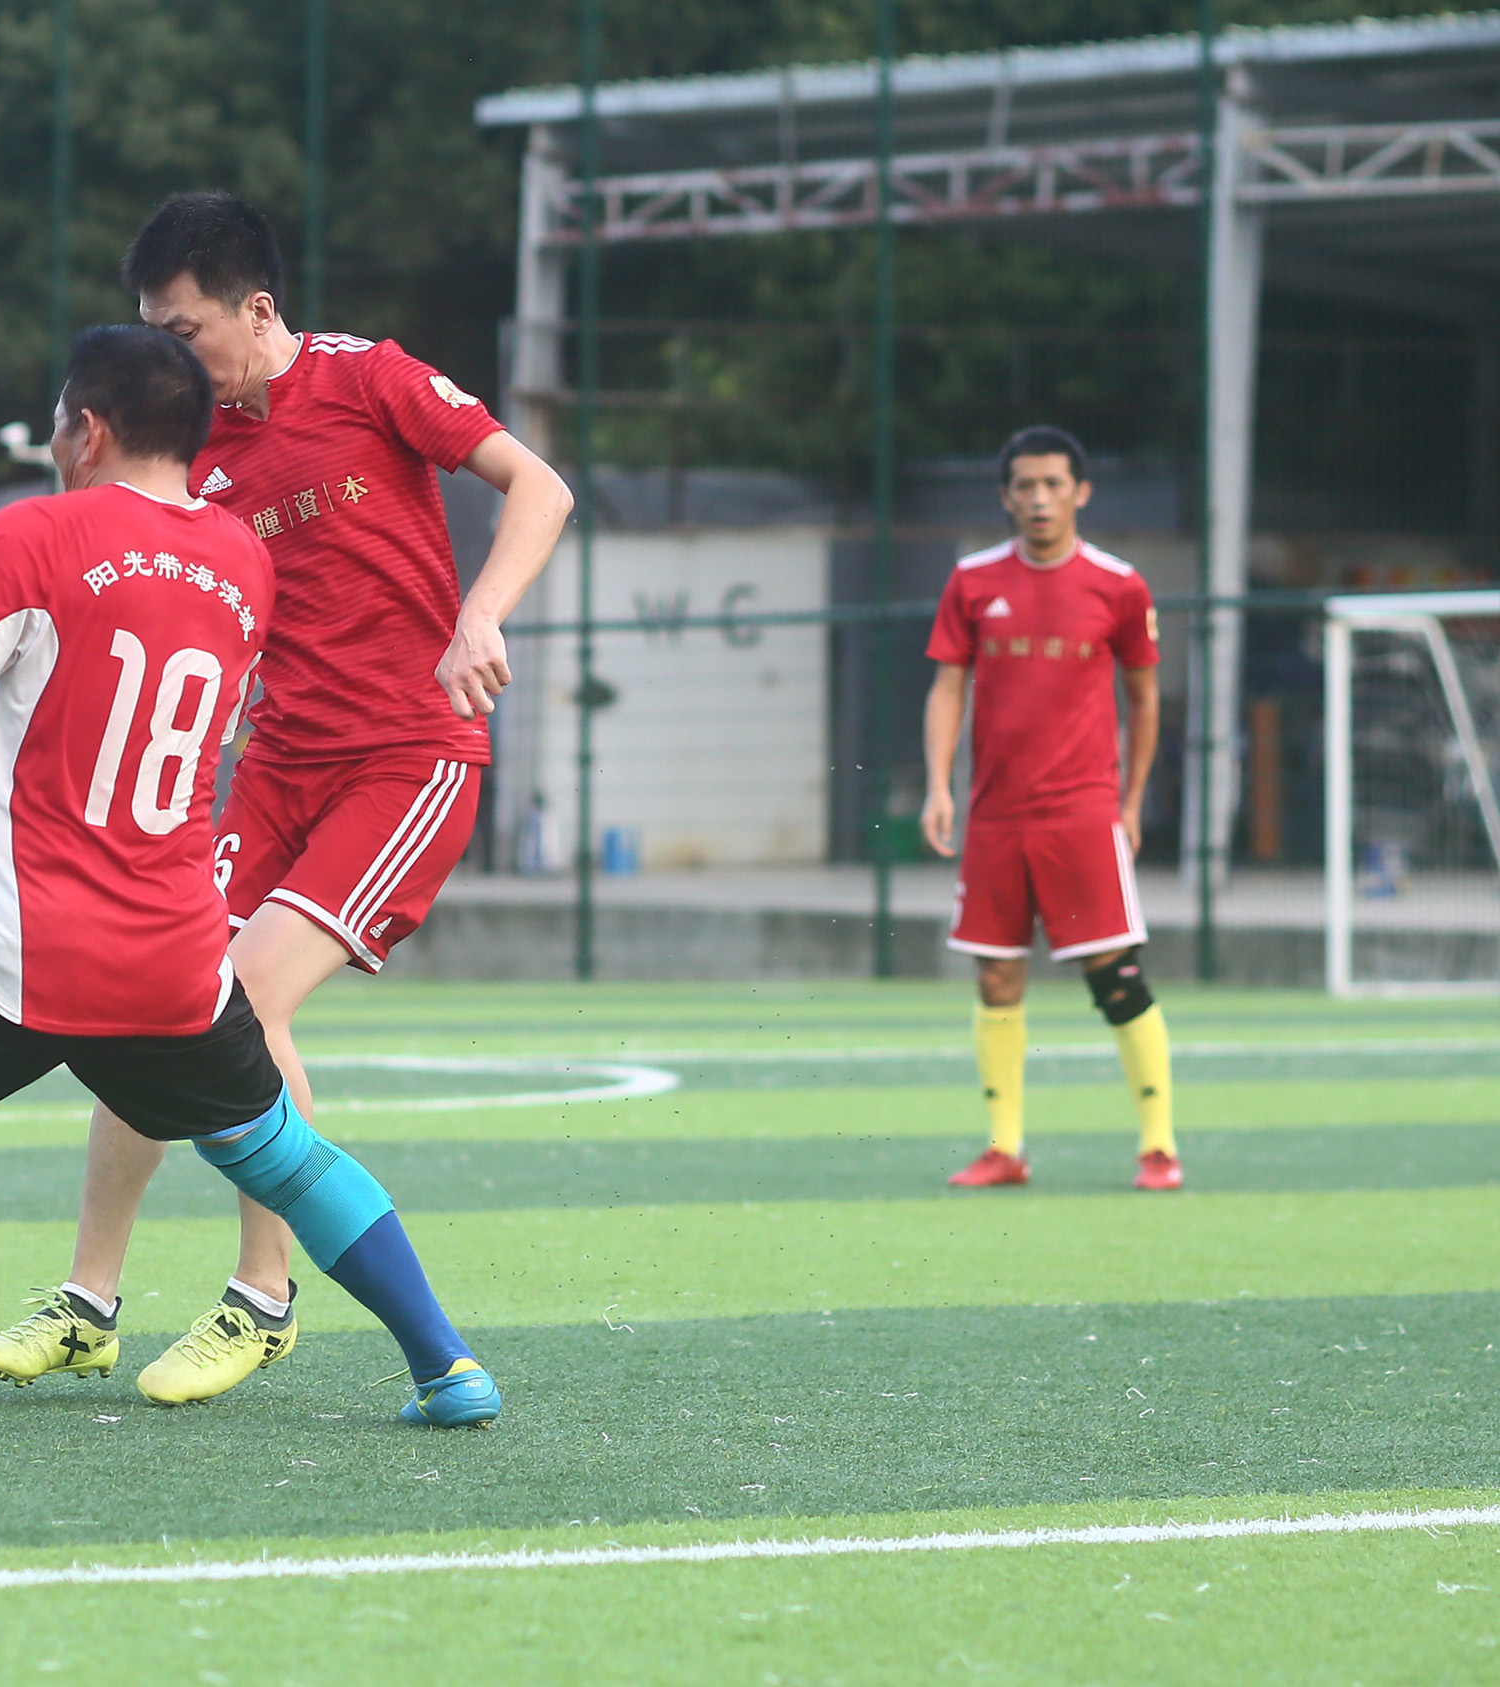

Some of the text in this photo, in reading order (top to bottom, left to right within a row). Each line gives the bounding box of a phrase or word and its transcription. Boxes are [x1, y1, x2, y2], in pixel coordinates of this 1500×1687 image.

[199, 478, 233, 496] adidas
[82, 550, 256, 642] 阳光带海滨城
[85, 628, 223, 836] 18
[213, 832, 242, 901] 6
